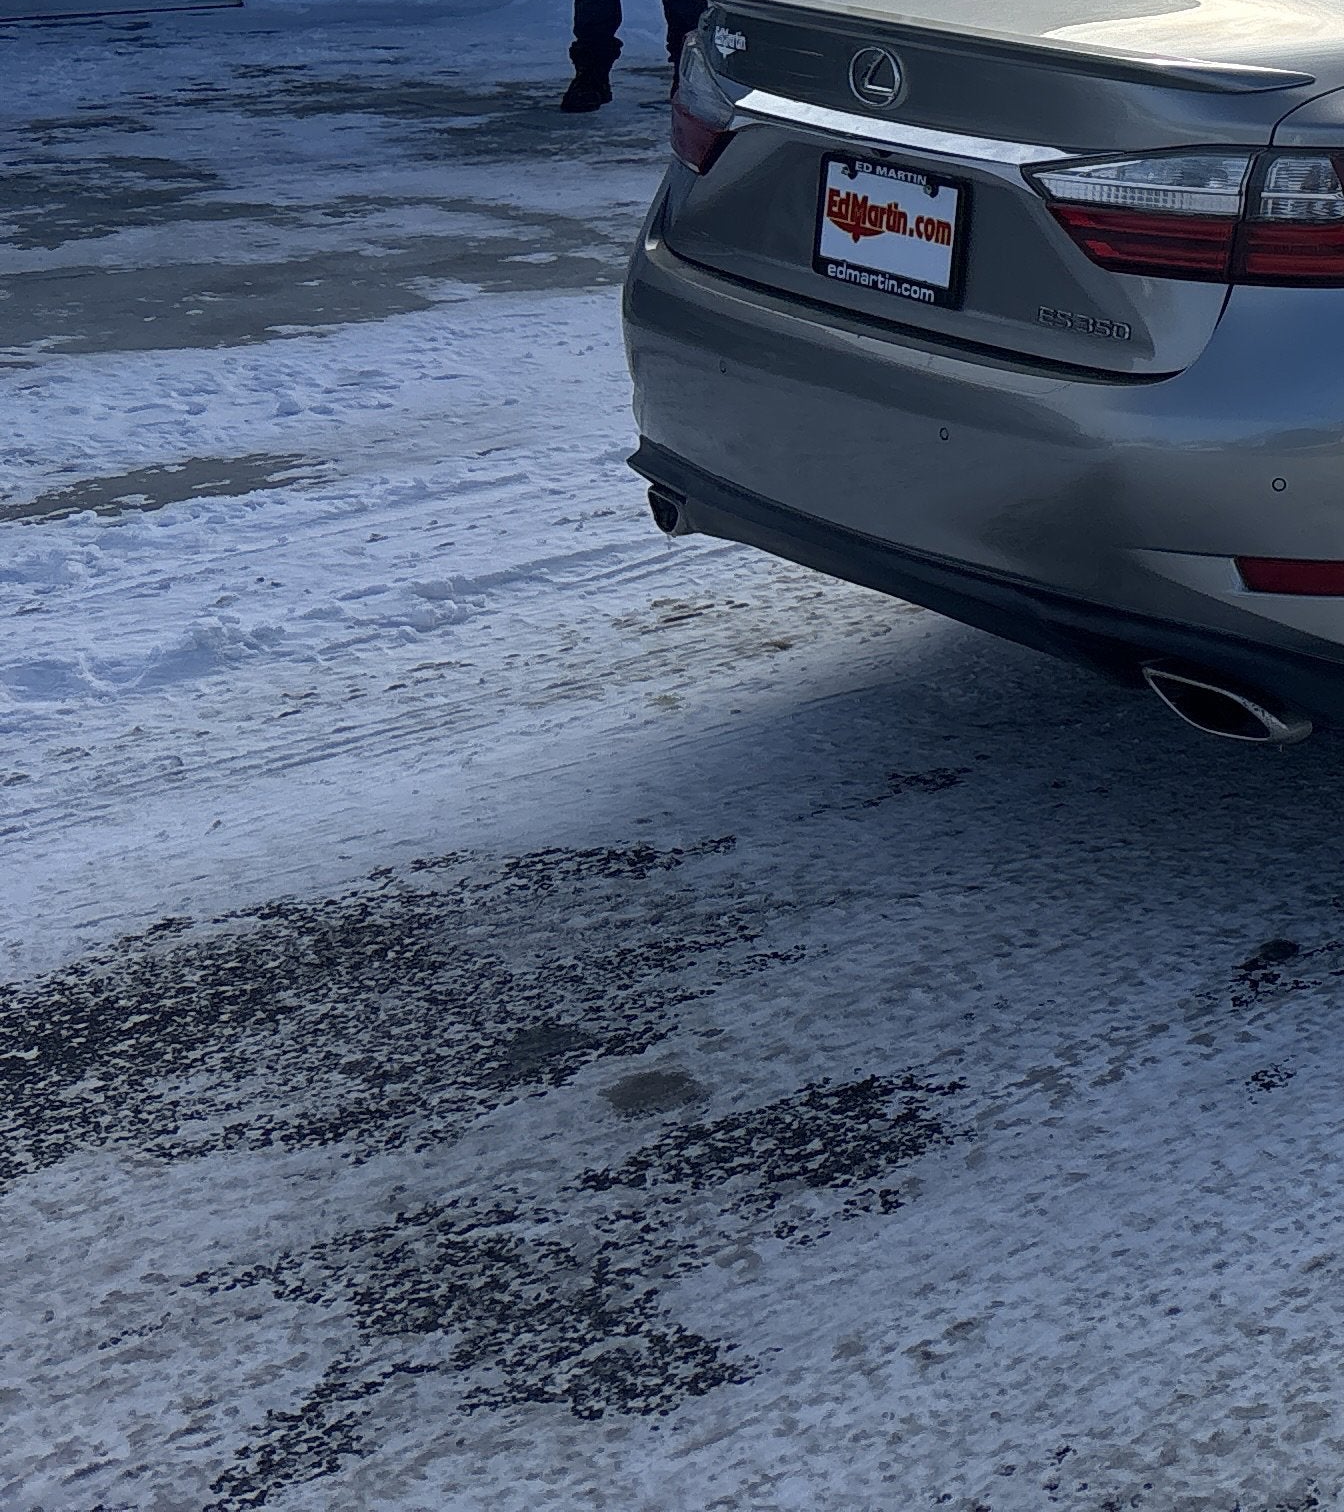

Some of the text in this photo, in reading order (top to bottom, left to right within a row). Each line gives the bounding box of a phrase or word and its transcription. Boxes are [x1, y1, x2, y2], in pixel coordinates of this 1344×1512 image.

[854, 161, 928, 186] ED MARTIN
[826, 187, 952, 247] EdMartin.com
[827, 262, 935, 303] edmartin.com
